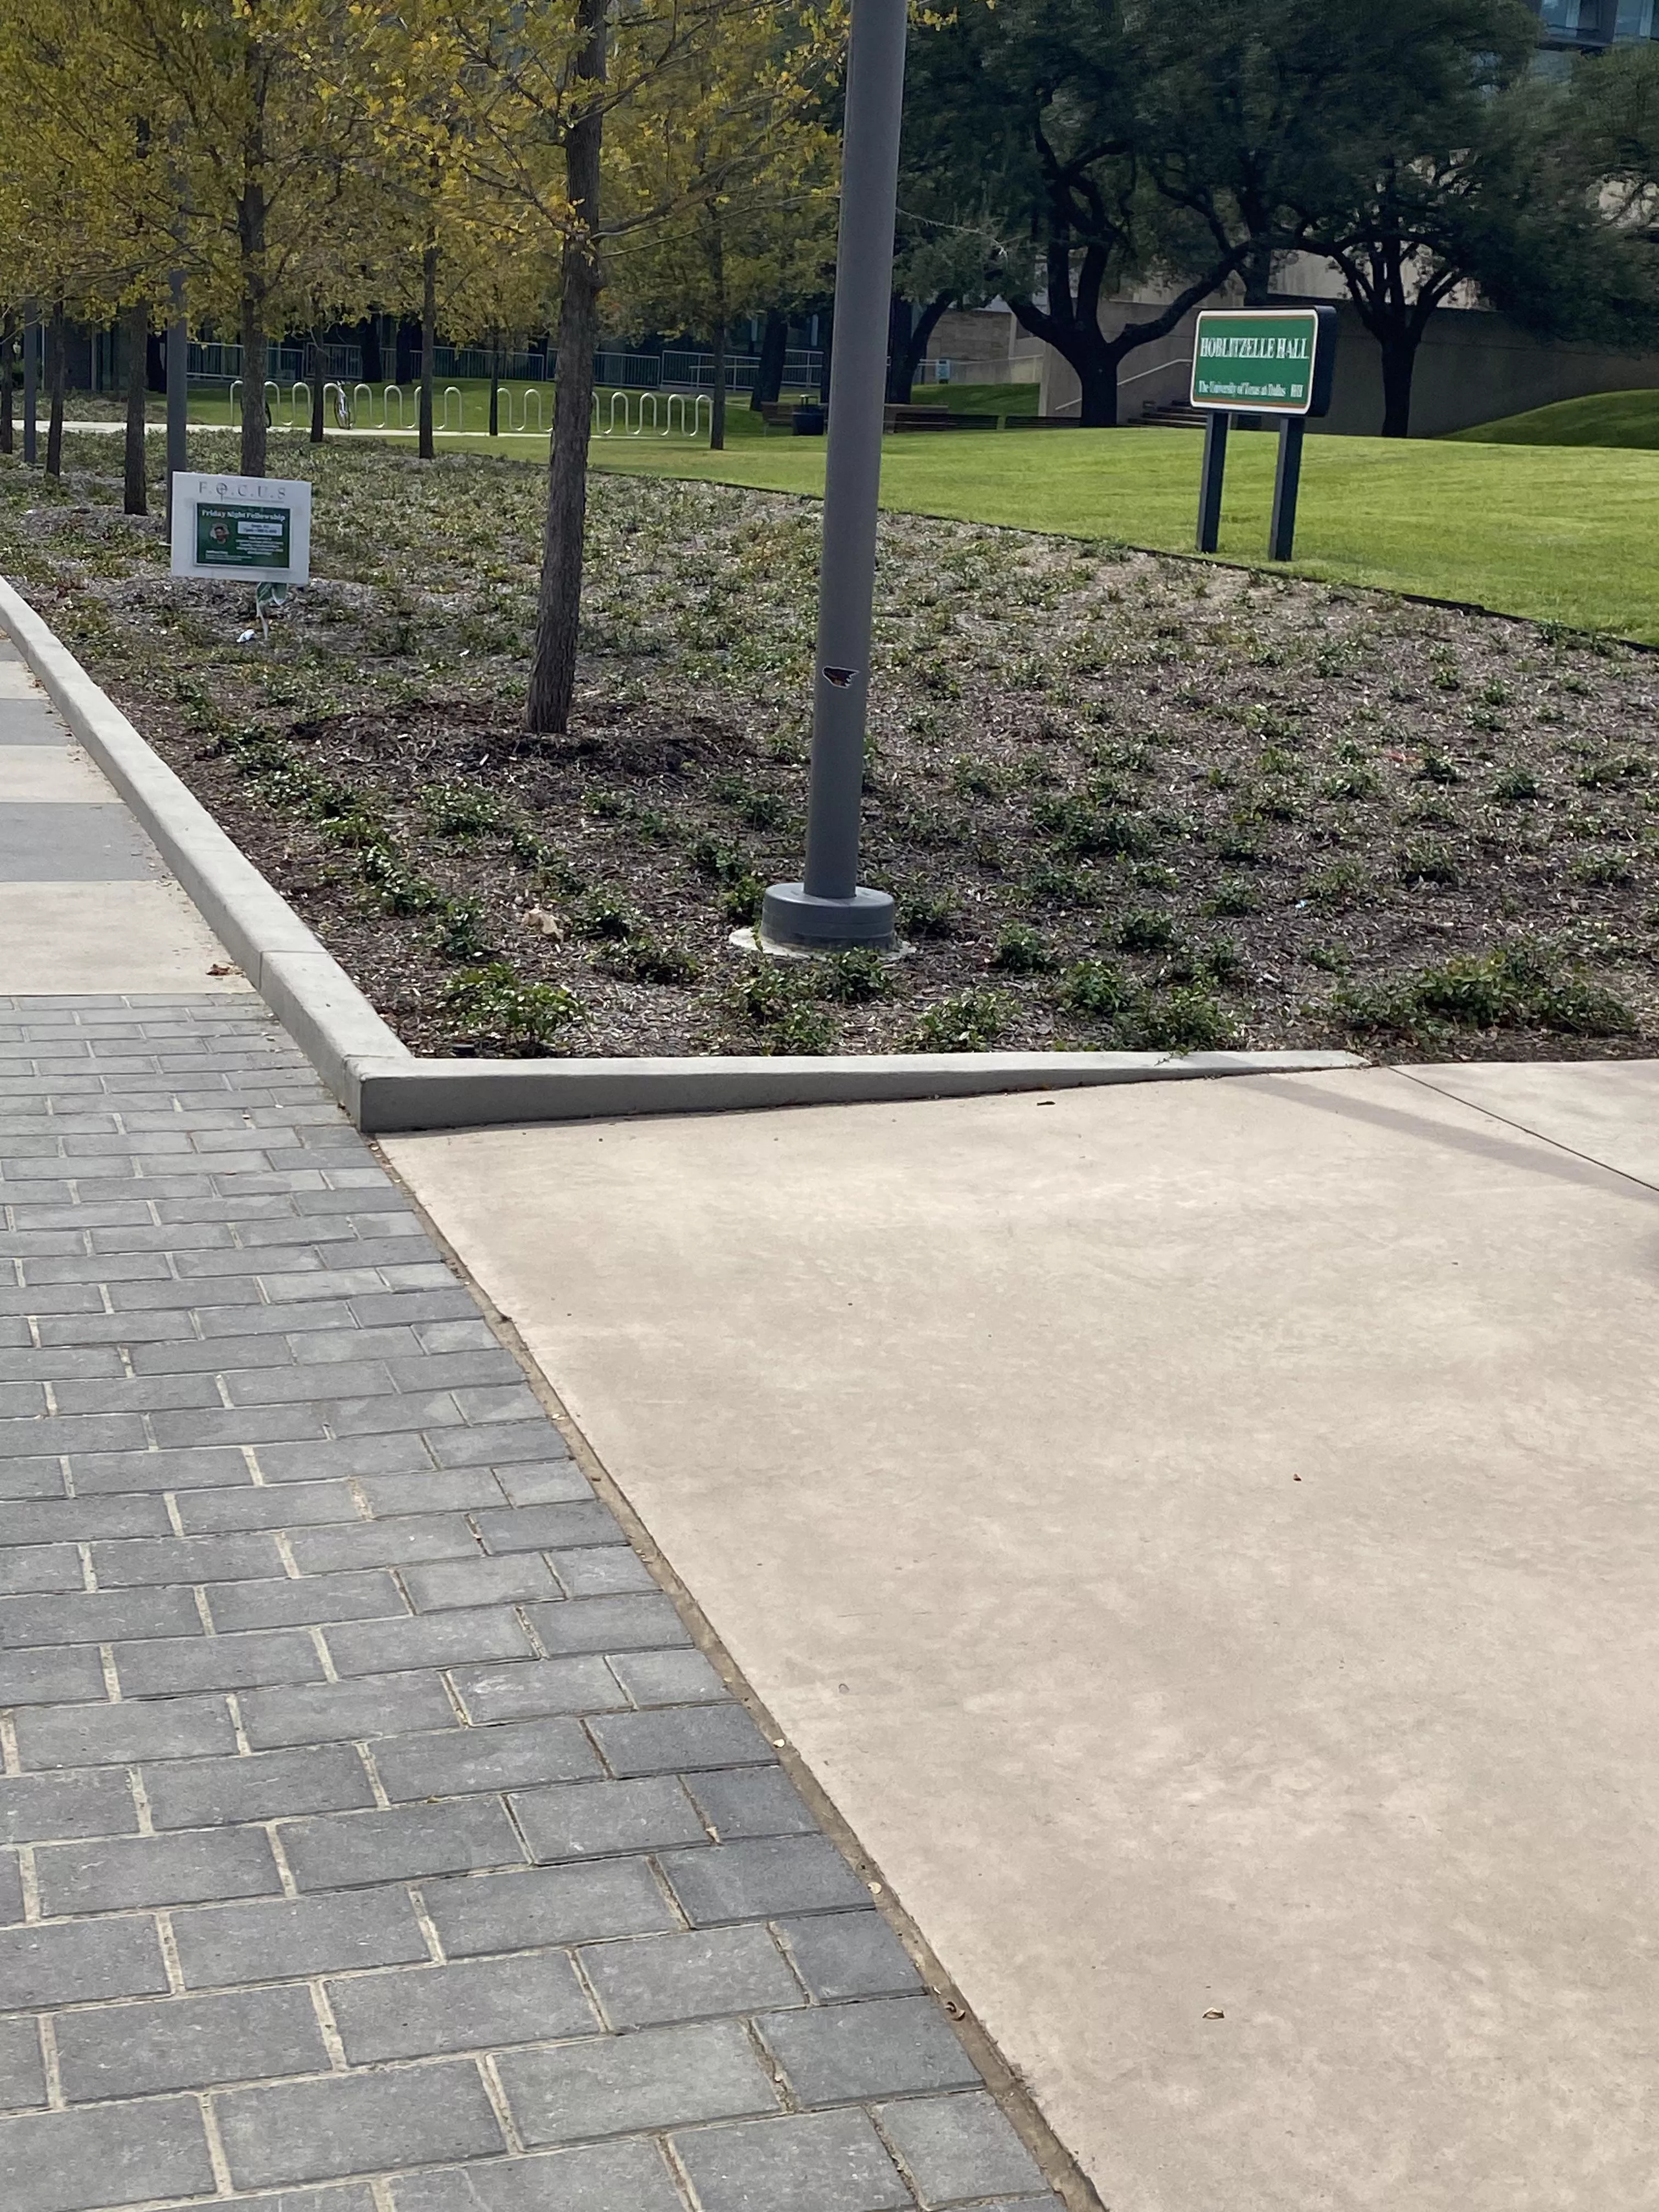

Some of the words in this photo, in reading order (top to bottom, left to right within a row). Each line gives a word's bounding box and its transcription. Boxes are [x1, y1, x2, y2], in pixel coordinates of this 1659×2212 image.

[1200, 337, 1275, 358] HOBLITZELLE
[1276, 338, 1309, 359] HALL
[202, 510, 225, 518] Friday
[247, 512, 285, 522] Fellowship
